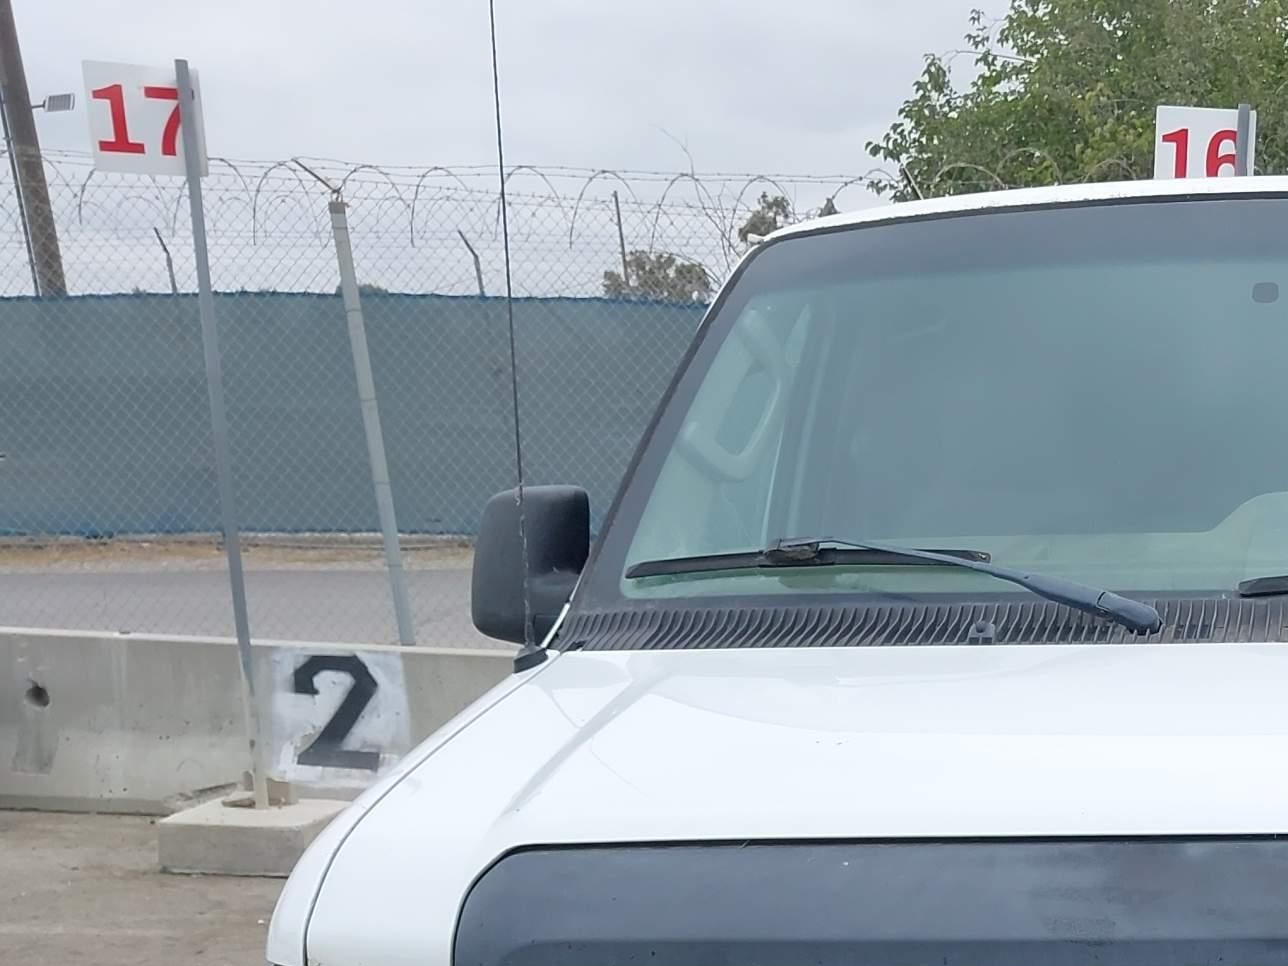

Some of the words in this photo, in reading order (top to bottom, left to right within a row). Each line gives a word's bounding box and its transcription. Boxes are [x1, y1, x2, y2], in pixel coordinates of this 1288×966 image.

[91, 83, 194, 157] 17
[1161, 127, 1238, 179] 16
[293, 655, 380, 772] 2
